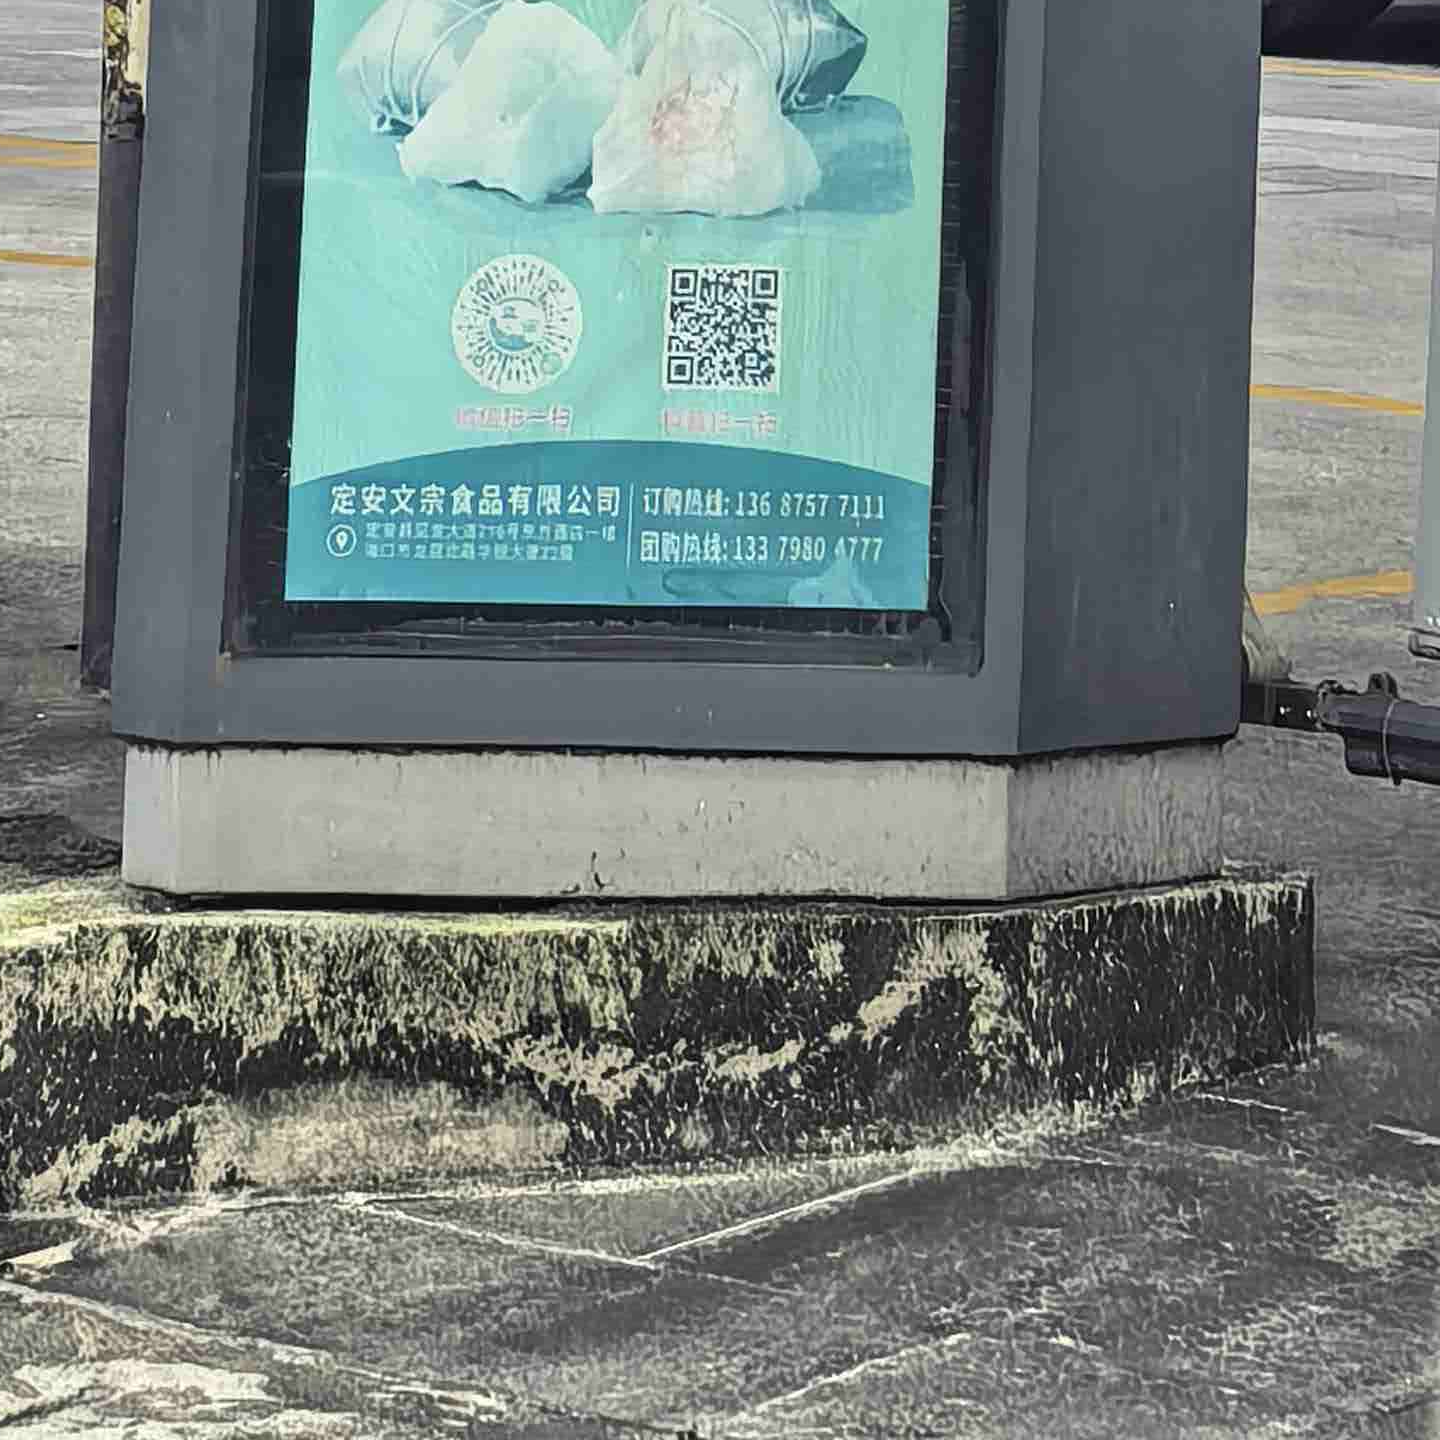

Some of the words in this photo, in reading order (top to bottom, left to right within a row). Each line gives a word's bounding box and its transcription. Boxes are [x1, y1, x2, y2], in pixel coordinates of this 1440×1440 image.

[330, 483, 621, 517] 定安文宗食品有限公司
[780, 492, 829, 518] 8757
[779, 537, 826, 561] 7980
